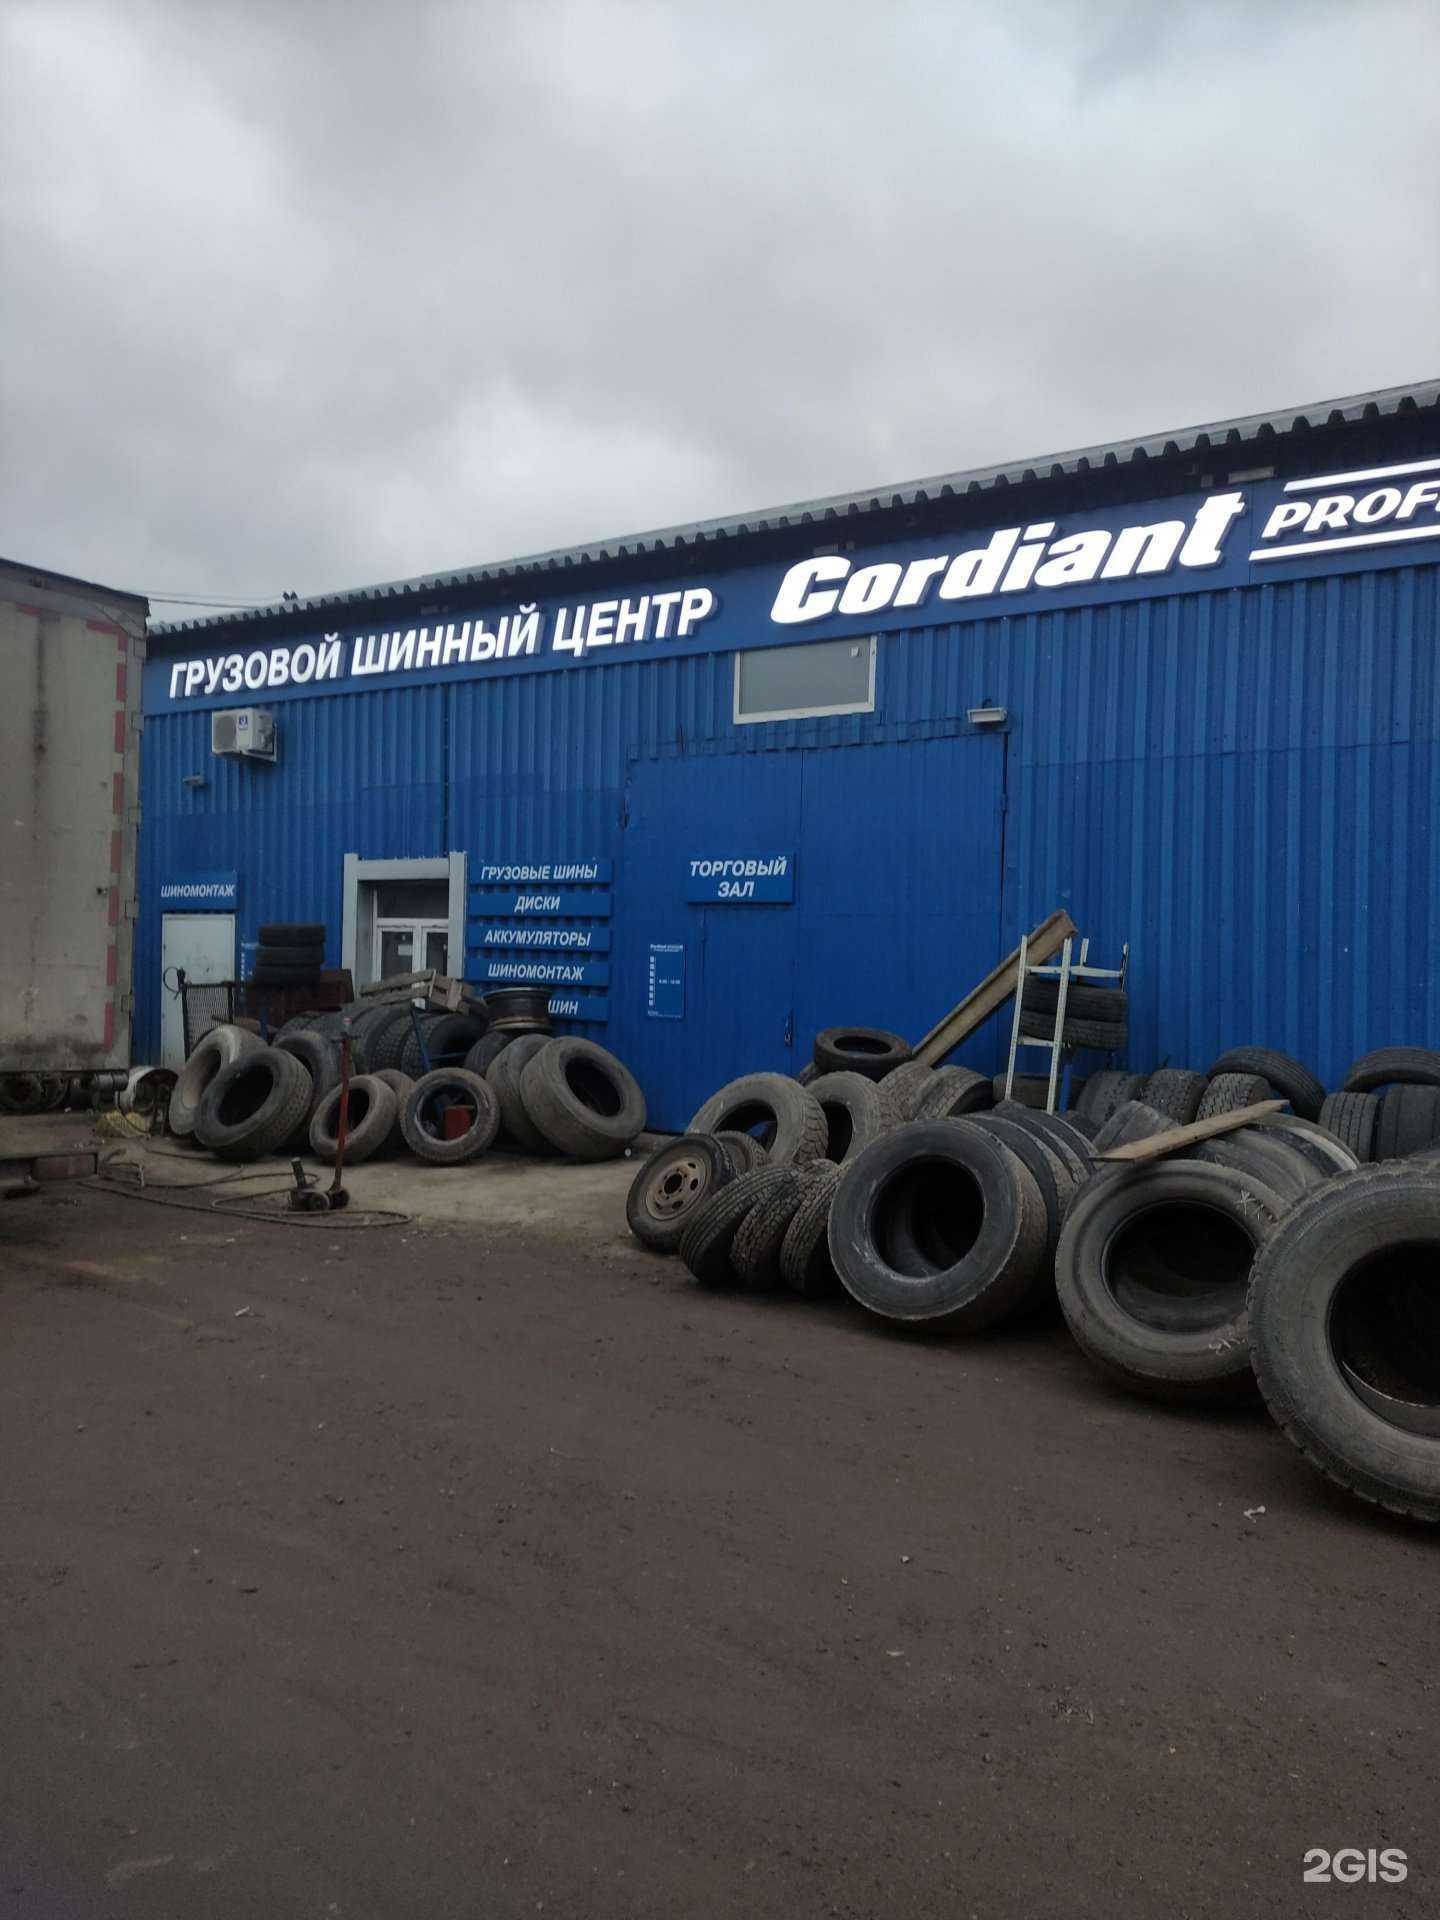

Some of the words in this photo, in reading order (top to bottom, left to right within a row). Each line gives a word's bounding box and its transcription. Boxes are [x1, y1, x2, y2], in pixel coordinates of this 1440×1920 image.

[1262, 480, 1440, 539] PROF
[770, 491, 1245, 624] Cordiant
[169, 633, 342, 698] ГРУЗОВОЙ
[350, 603, 541, 677] ШИННЫЙ
[552, 587, 714, 657] ЦЕНТР
[480, 864, 551, 881] ГРУЗОВЫЕ
[553, 863, 598, 880] ШИНЫ
[689, 855, 787, 877] ТОРГОВЫЙ
[160, 884, 235, 898] ШИНОМОНТАЖ
[717, 881, 755, 898] ЗАЛ
[514, 895, 560, 913] ДИСКИ
[484, 929, 592, 948] АККУМУЛЯТОРЫ
[487, 962, 585, 981] ШИНОМОНТАЖ
[547, 999, 579, 1016] ШИН
